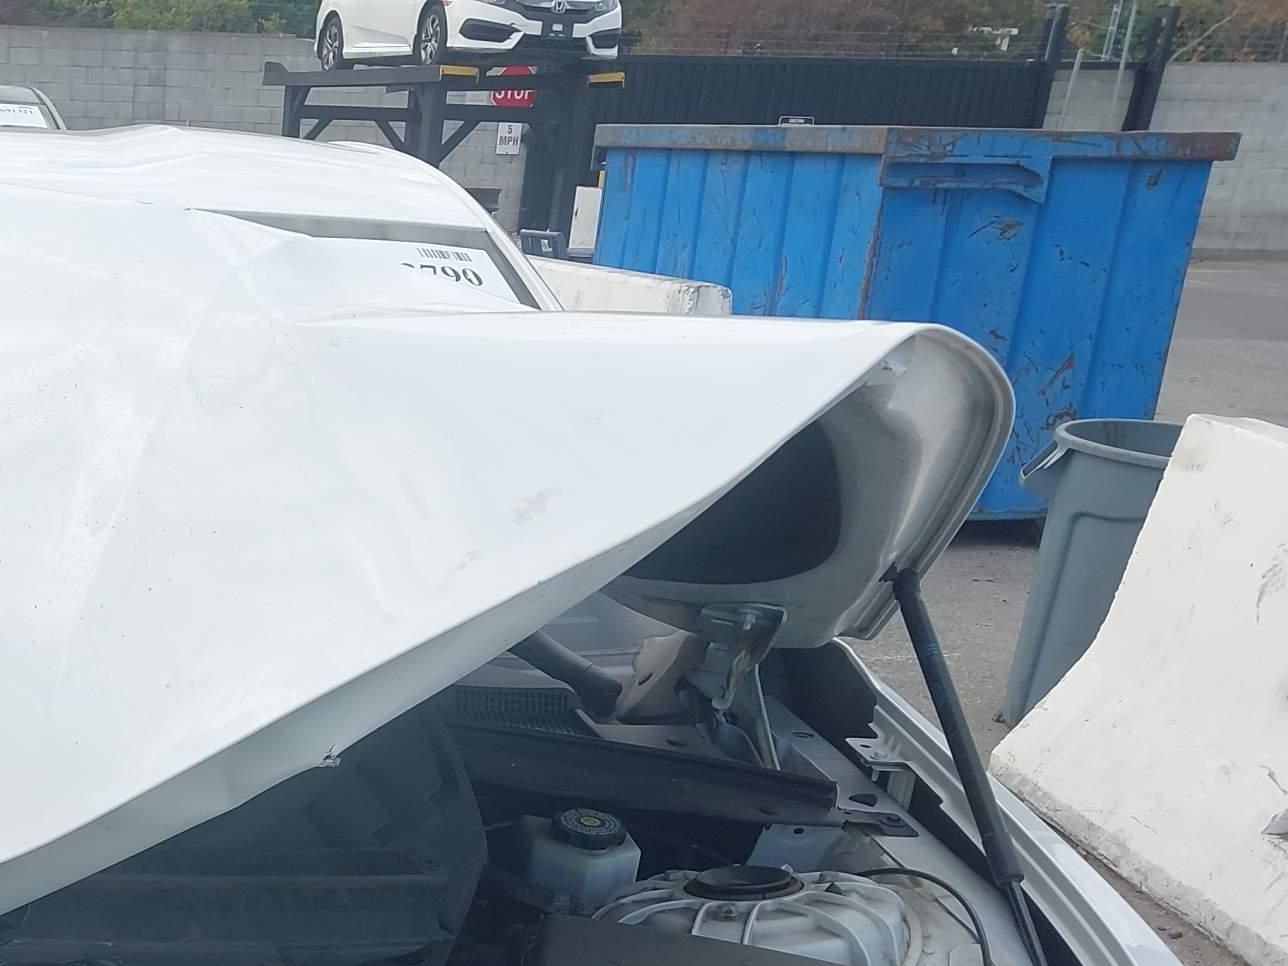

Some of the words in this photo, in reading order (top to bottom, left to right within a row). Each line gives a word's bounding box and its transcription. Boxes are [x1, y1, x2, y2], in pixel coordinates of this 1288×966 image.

[507, 124, 513, 135] 5
[498, 135, 520, 146] MPH
[399, 261, 484, 287] 790
